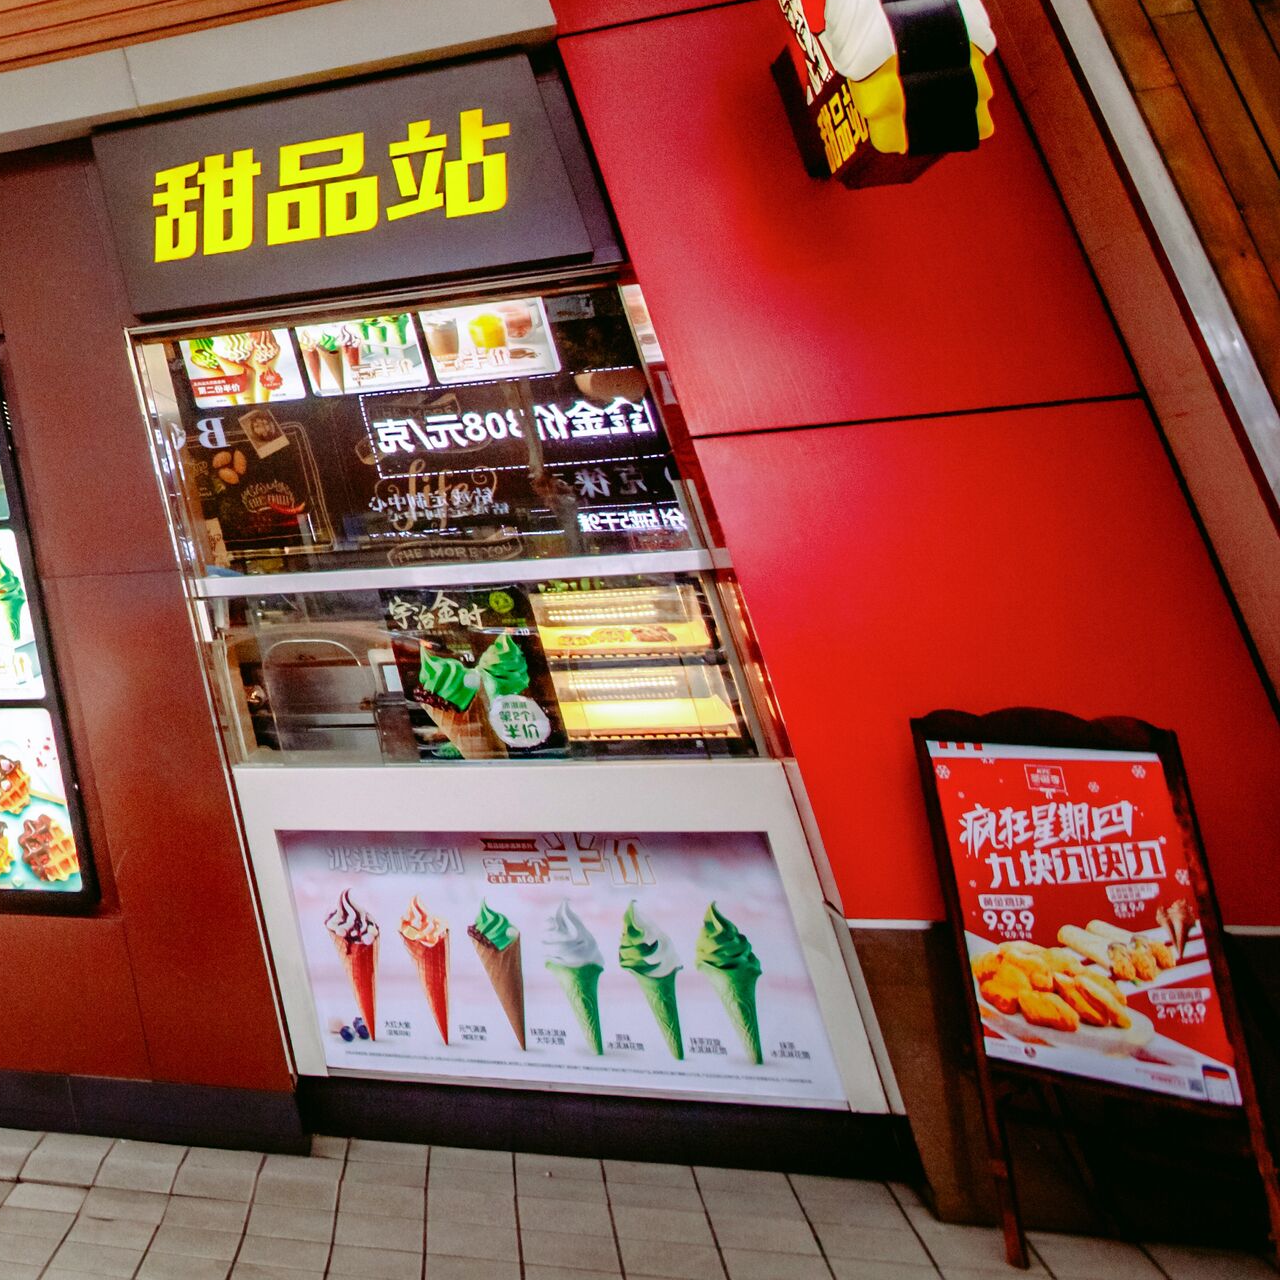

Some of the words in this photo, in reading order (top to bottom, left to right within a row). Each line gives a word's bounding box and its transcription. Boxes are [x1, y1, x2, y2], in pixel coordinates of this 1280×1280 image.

[152, 107, 512, 263] 甜品站
[389, 589, 487, 631] 宇治金时
[958, 799, 1134, 859] 疯狂星期四
[327, 846, 465, 875] 冰淇淋系列
[544, 832, 656, 886] 半价
